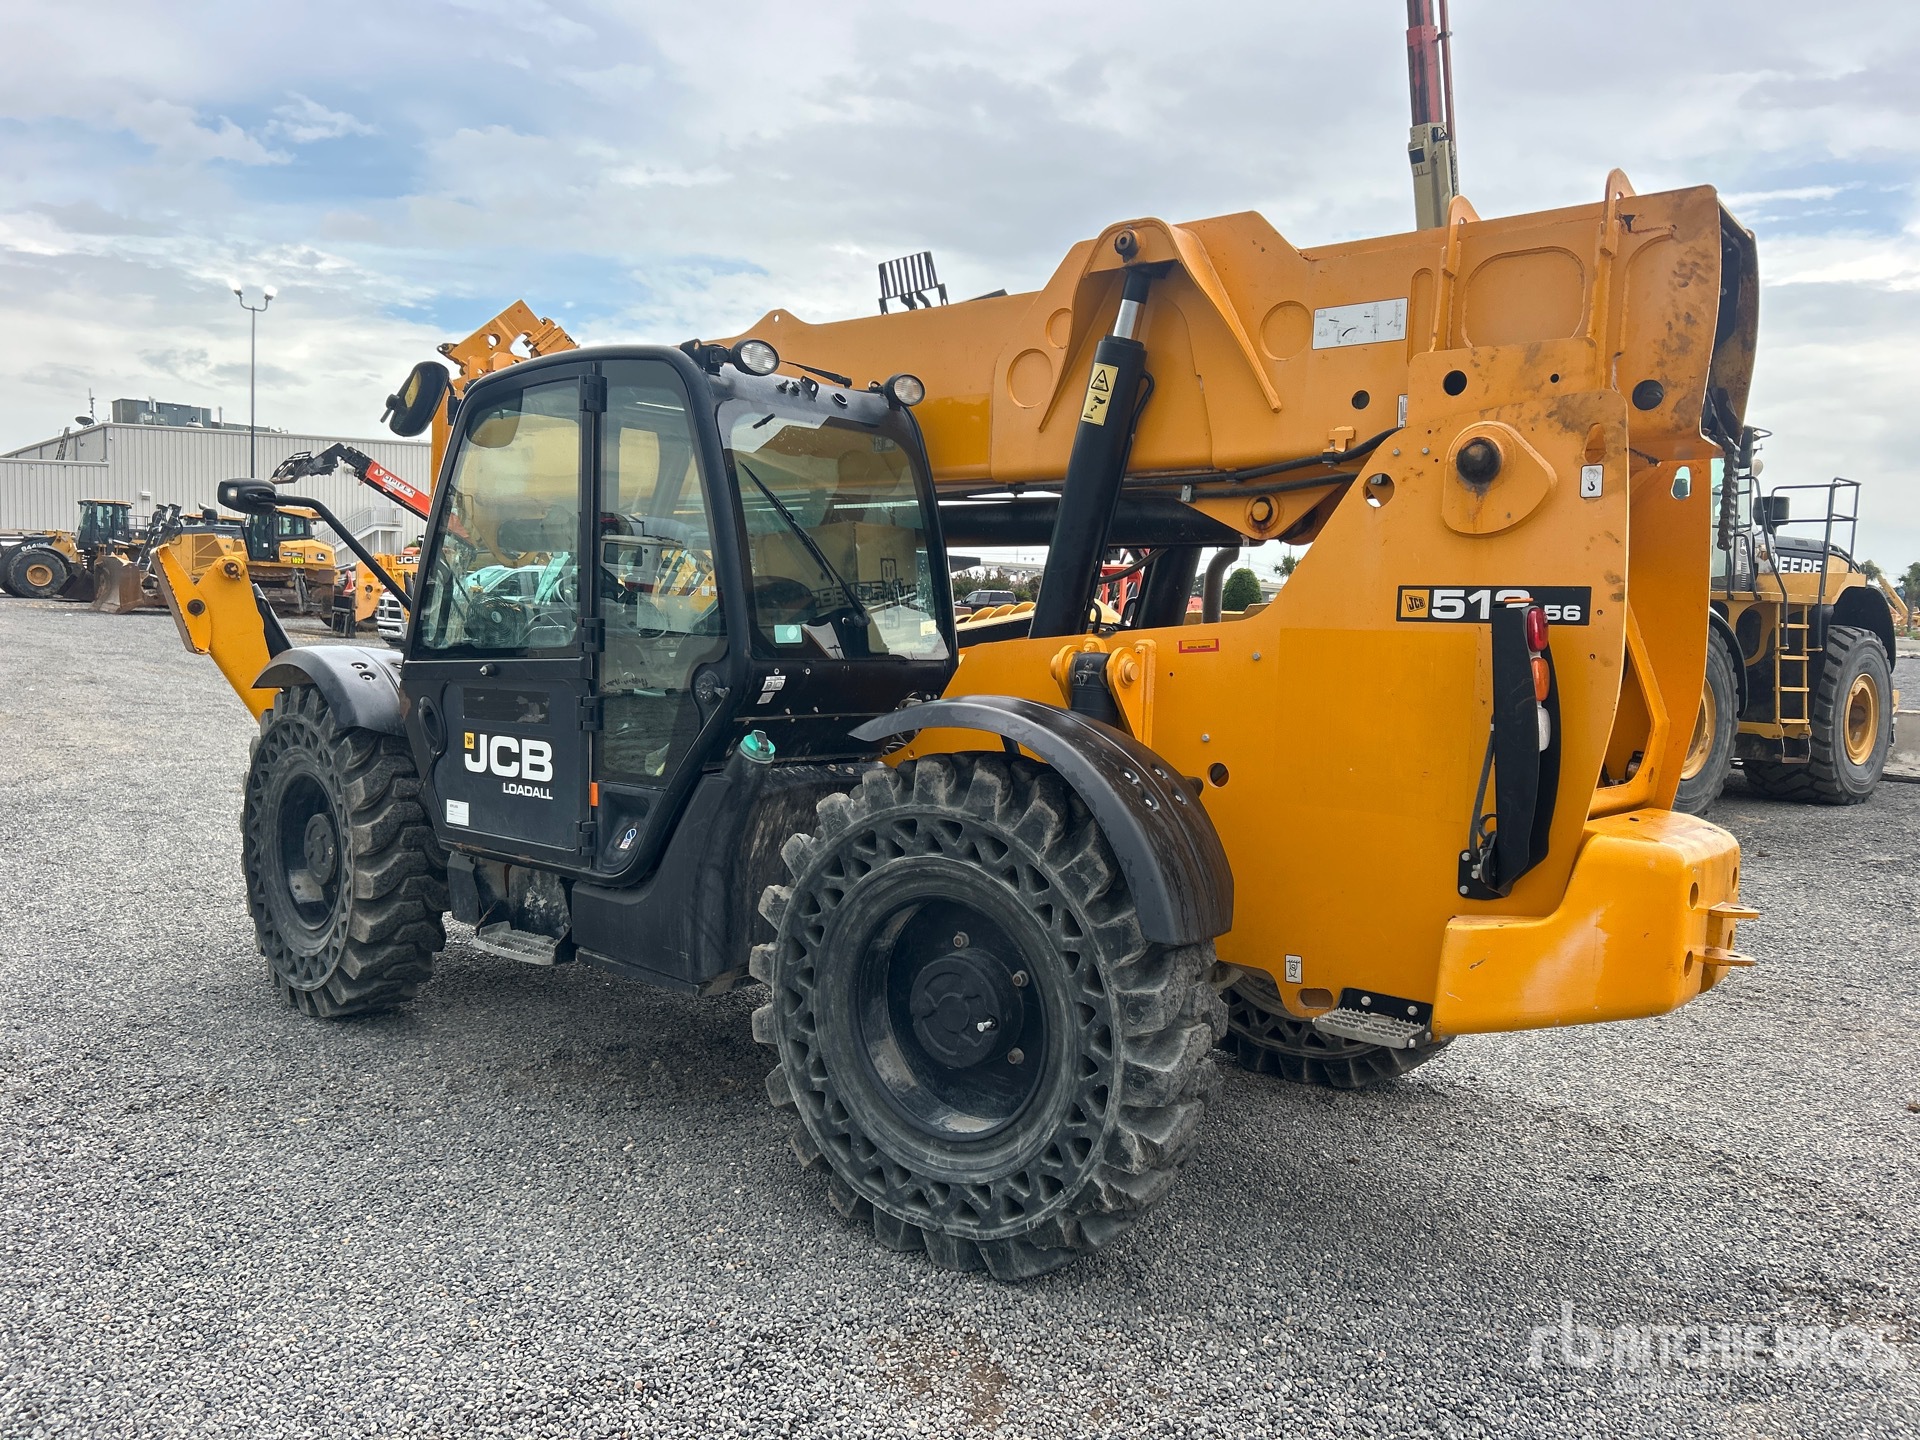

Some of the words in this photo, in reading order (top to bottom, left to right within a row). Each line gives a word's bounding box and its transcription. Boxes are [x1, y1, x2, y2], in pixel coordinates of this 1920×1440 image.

[1409, 596, 1424, 610] JCB
[1543, 604, 1581, 621] 56
[464, 733, 554, 782] JCB
[503, 782, 554, 800] LOADALL
